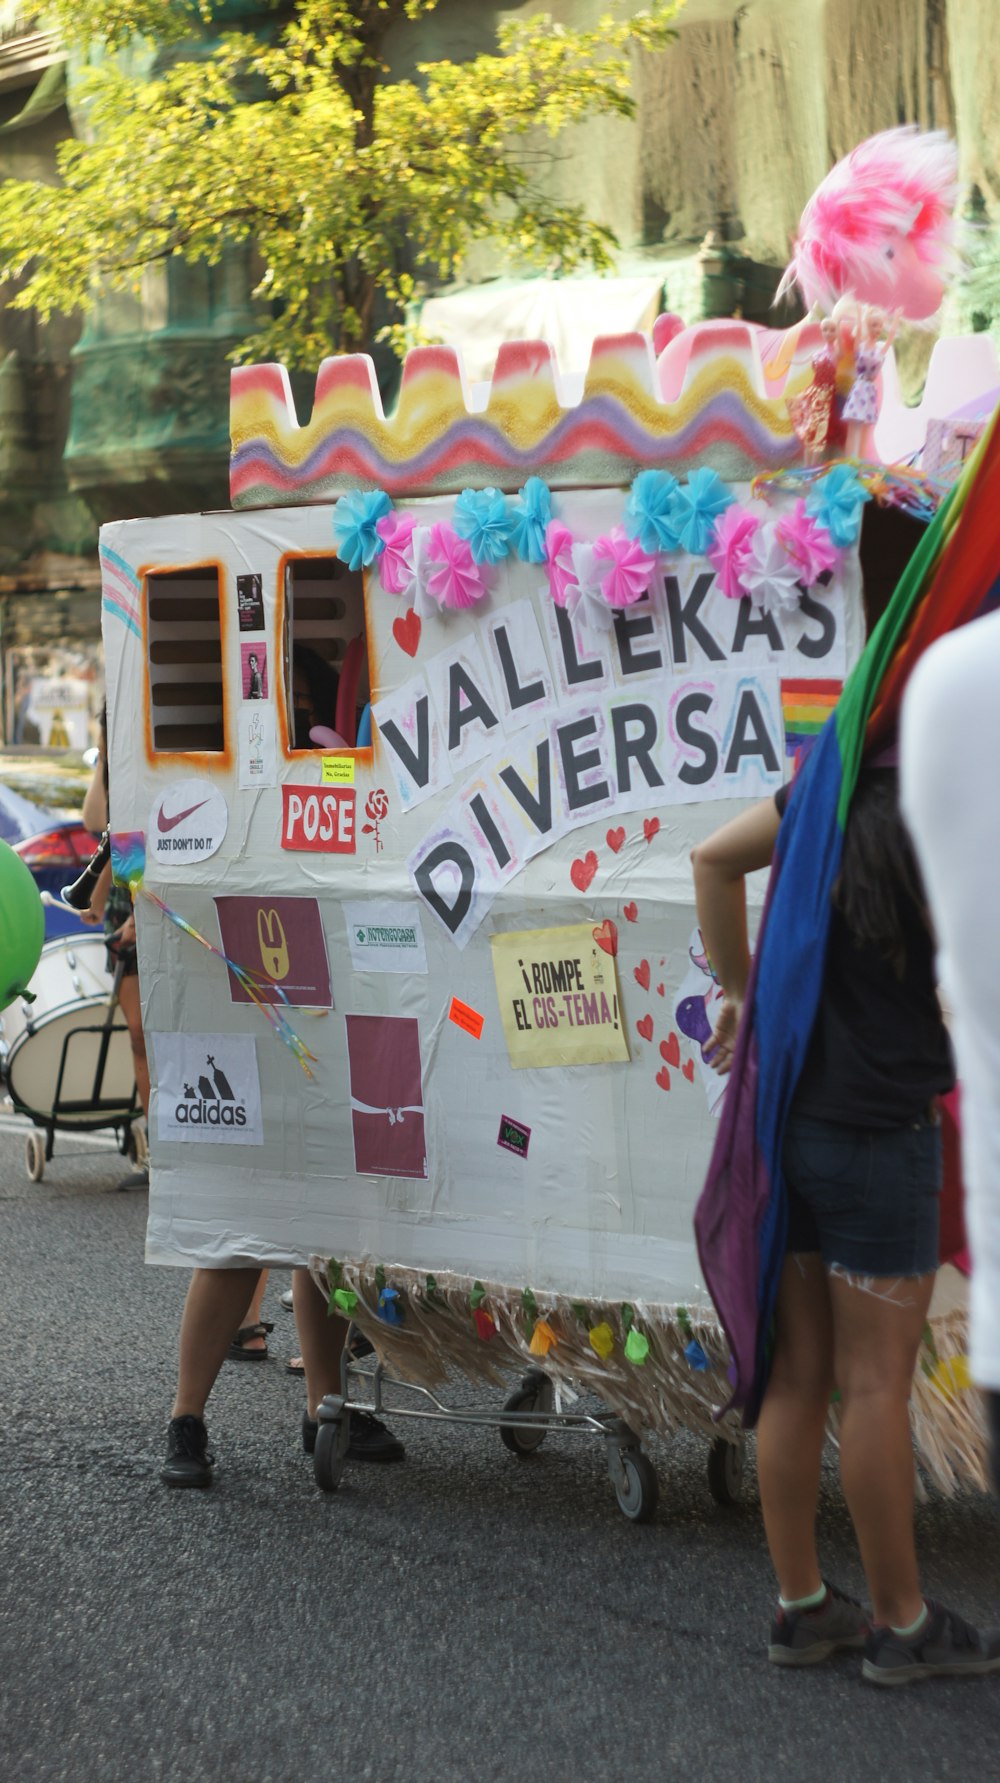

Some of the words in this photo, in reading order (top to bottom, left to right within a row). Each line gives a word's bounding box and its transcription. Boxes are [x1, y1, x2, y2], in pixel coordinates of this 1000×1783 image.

[378, 569, 837, 789] VALLEKAS
[286, 794, 353, 842] POSE
[414, 690, 780, 934] DIVERSA
[157, 838, 172, 851] JUST
[172, 838, 193, 850] DON'T
[194, 838, 204, 850] DO
[512, 999, 532, 1030] EL
[175, 1100, 247, 1126] adidas
[505, 1127, 525, 1146] VOX
